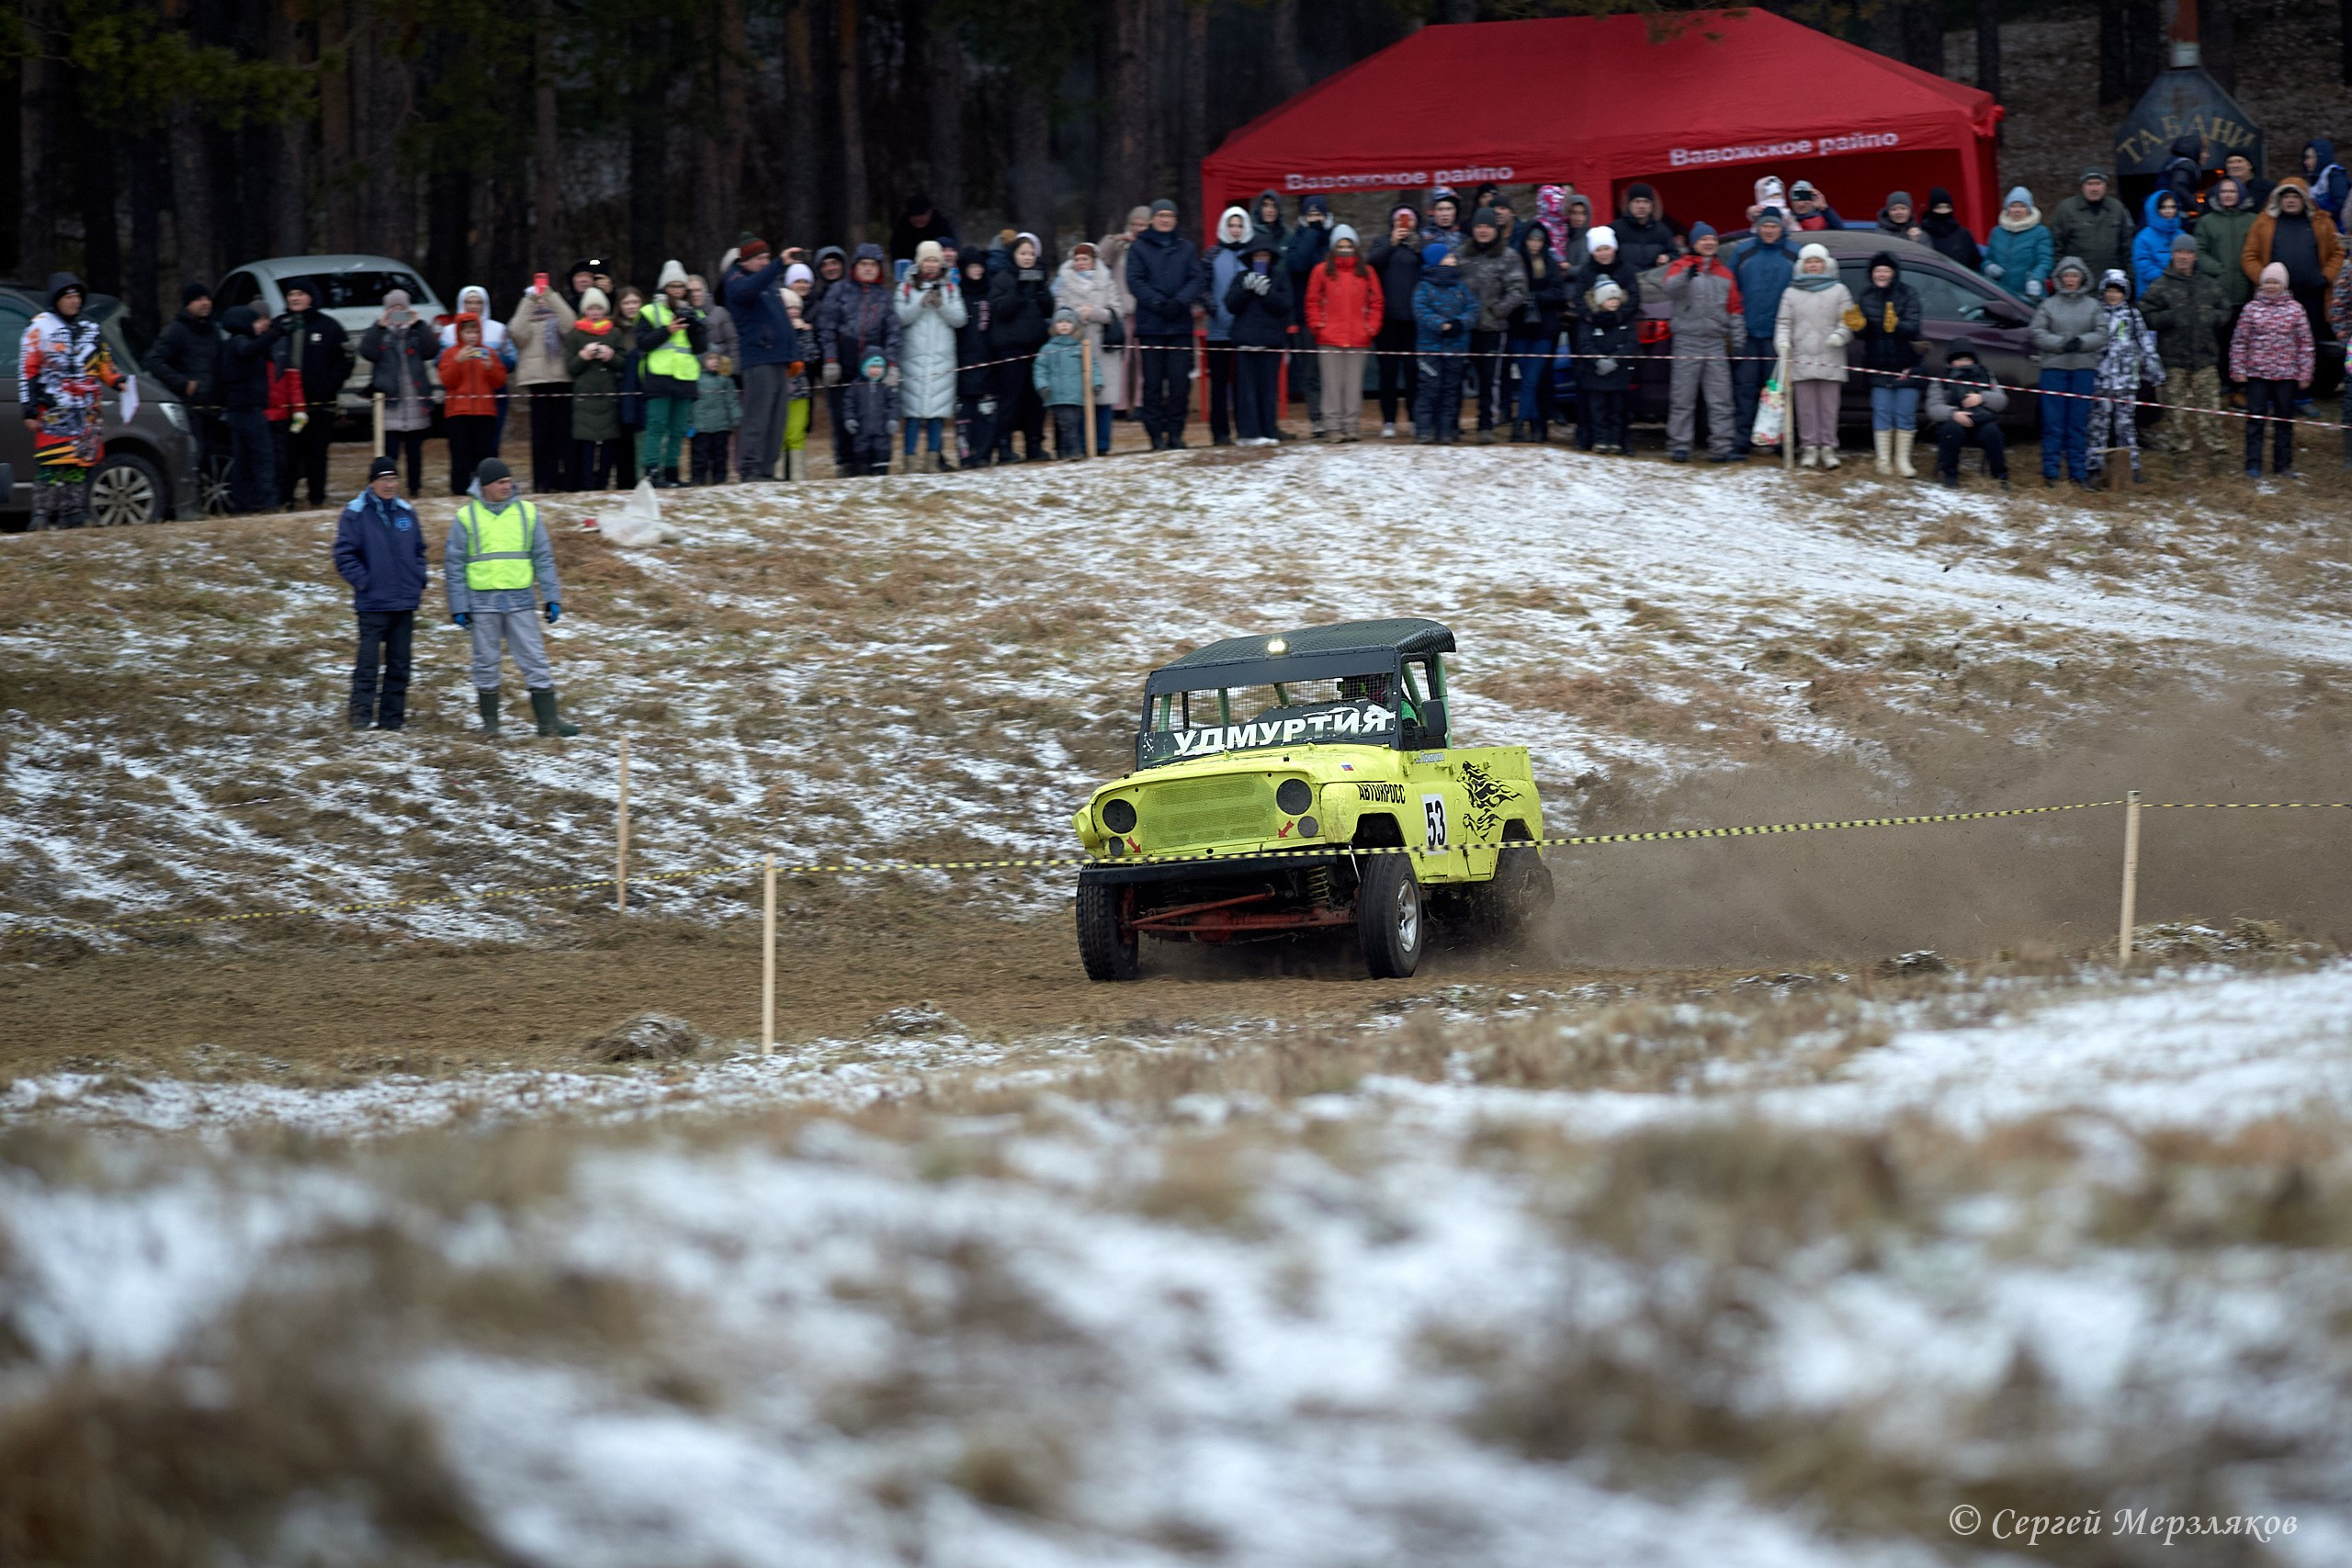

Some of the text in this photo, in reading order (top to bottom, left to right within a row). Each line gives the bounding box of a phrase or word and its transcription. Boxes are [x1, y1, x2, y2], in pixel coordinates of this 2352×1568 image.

[1669, 132, 1899, 166] Вавожское райпо
[2116, 114, 2256, 163] ТАБАНИ
[1284, 165, 1514, 190] Вавожское райпо
[1173, 707, 1390, 756] УДМУРТИЯ
[1357, 784, 1406, 805] АВТОКРОСС
[1425, 800, 1446, 847] 53
